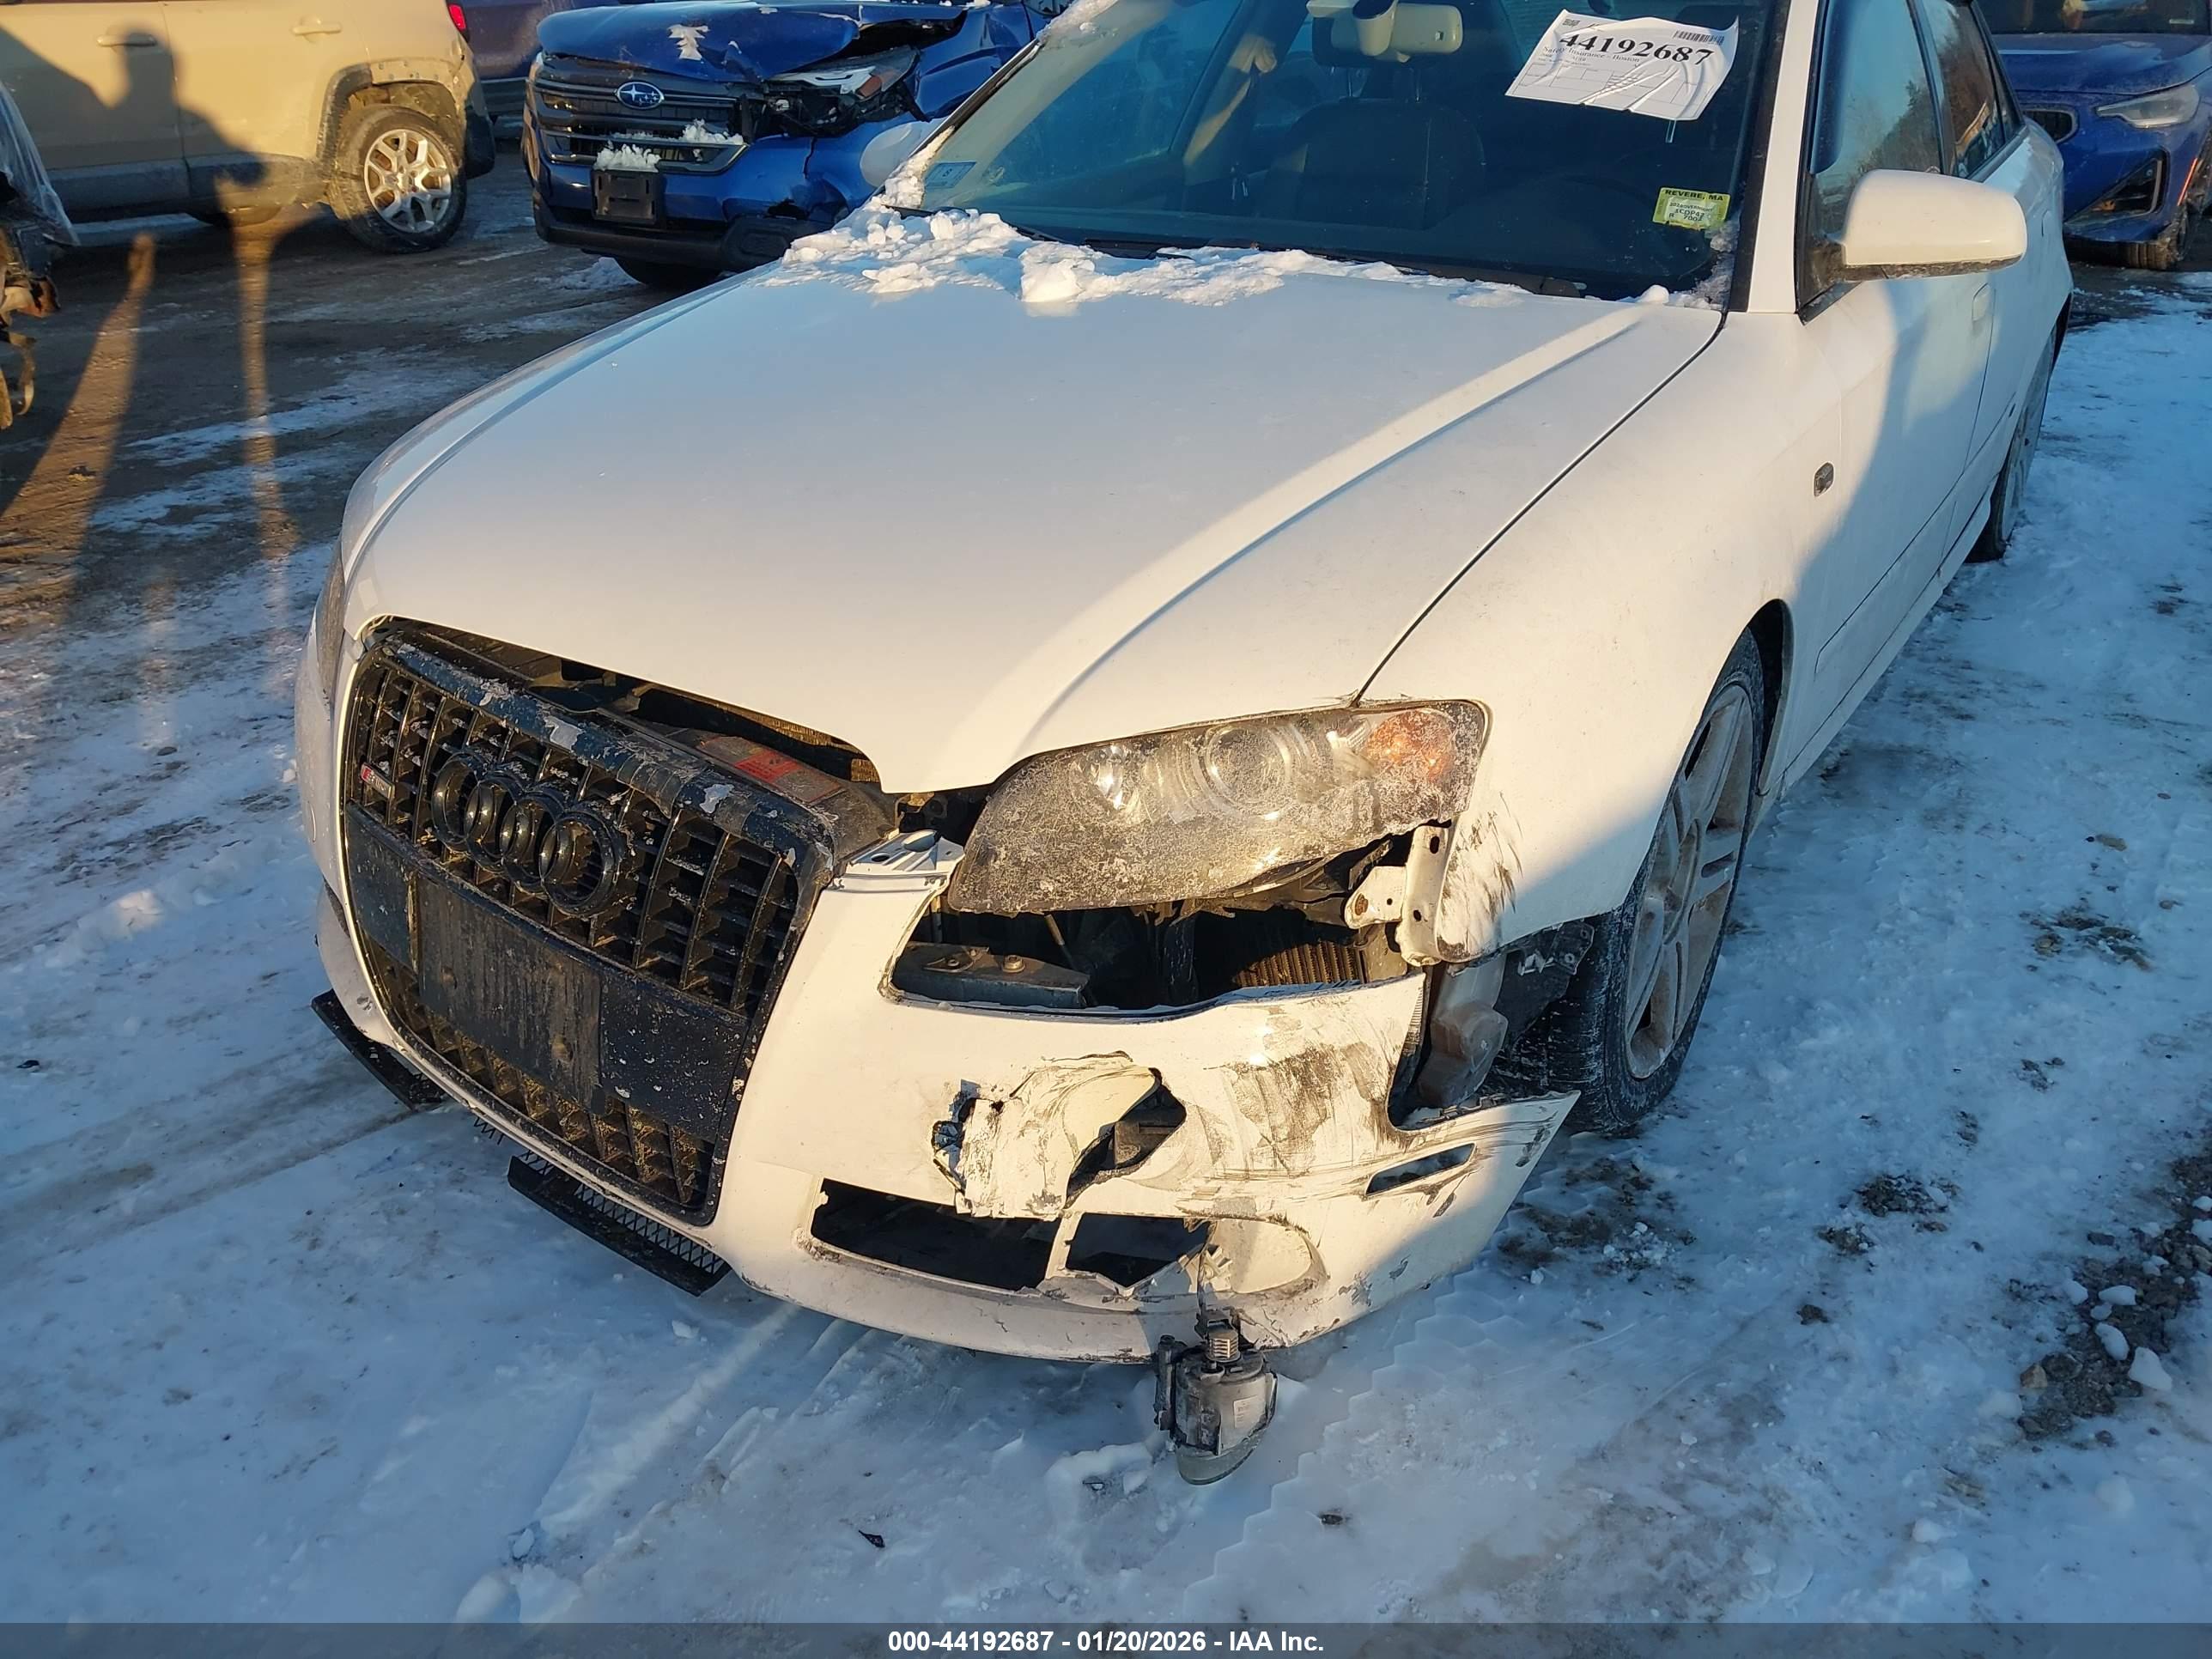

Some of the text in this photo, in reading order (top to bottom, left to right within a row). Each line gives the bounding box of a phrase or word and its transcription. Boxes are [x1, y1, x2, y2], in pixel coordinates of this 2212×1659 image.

[1543, 46, 1567, 55] Safety
[1568, 47, 1606, 59] Insurance
[1613, 54, 1641, 63] Boston
[1559, 33, 1716, 65] 44192687
[1665, 190, 1706, 200] REVERE,
